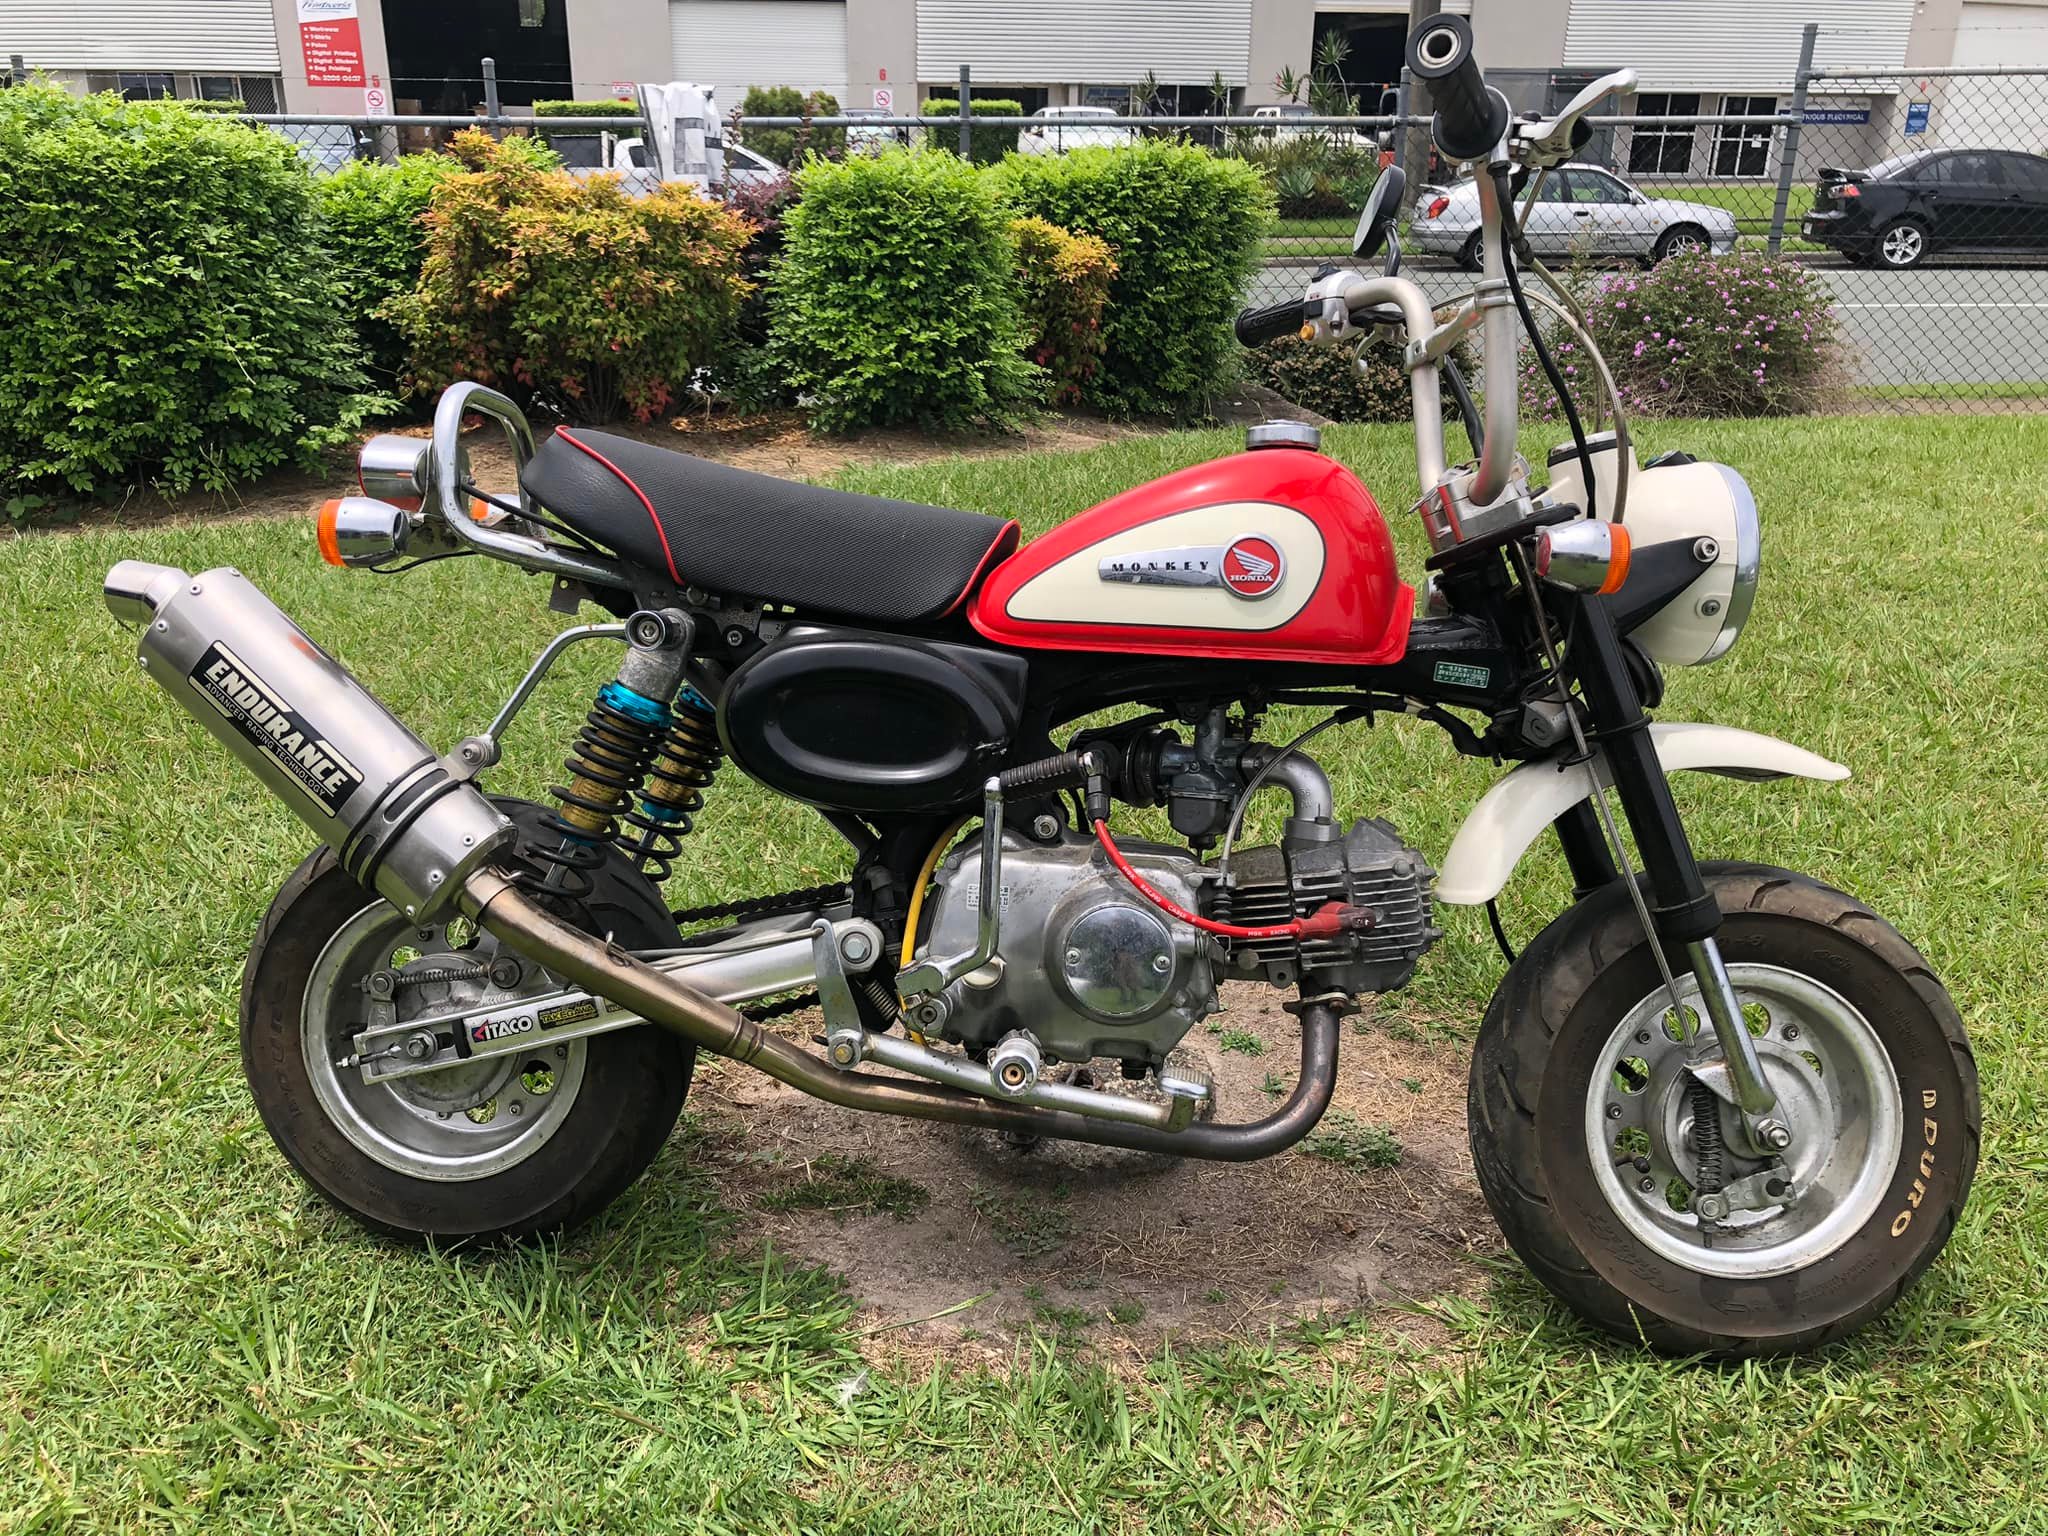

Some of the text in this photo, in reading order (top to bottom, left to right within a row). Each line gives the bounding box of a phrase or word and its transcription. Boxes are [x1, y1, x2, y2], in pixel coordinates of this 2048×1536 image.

[371, 75, 380, 88] 5
[1111, 560, 1209, 573] MONKEY
[1229, 574, 1274, 582] HONDA
[204, 682, 326, 796] ADVANCED RACING TECHNOLOGY
[205, 658, 348, 793] ENDURANCE
[1890, 1116, 1938, 1238] DURO
